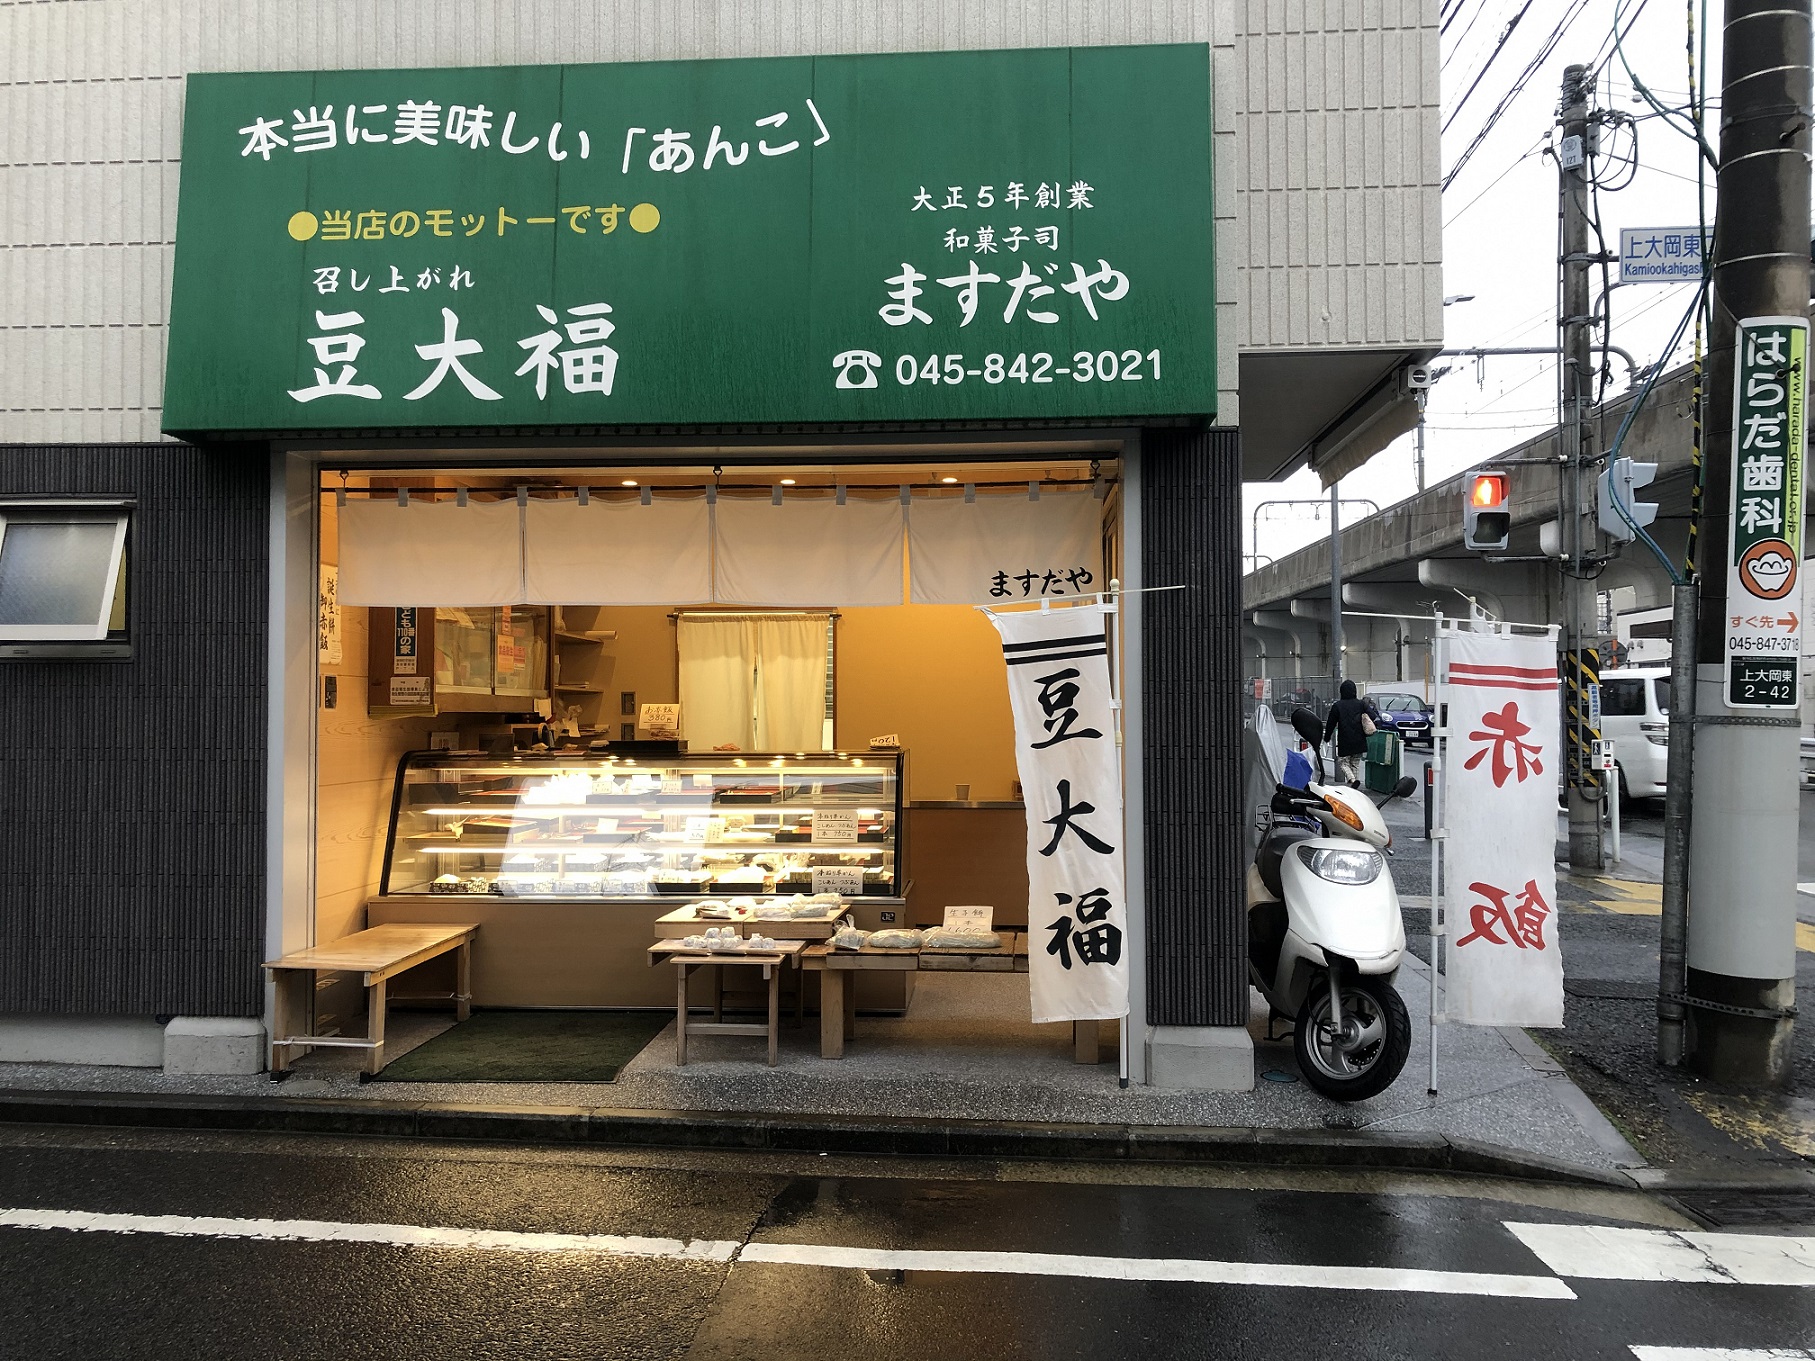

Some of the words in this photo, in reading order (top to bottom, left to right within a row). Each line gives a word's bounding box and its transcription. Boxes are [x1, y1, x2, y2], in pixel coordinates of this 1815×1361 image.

[910, 179, 1095, 211] 大正5年創業
[321, 204, 626, 241] 当店のモットーです
[943, 225, 1059, 255] 和菓子司
[312, 265, 475, 294] 召し上がれ
[878, 258, 1130, 328] ますだや
[286, 302, 619, 402] 豆大福
[896, 348, 1161, 386] 045-842-3021
[1740, 331, 1787, 534] はらだ歯科
[989, 566, 1093, 597] ますだや
[1730, 615, 1774, 629] すぐ先
[1740, 668, 1792, 682] 上大岡東
[1744, 684, 1790, 699] 2-42
[1030, 667, 1122, 971] 豆大福
